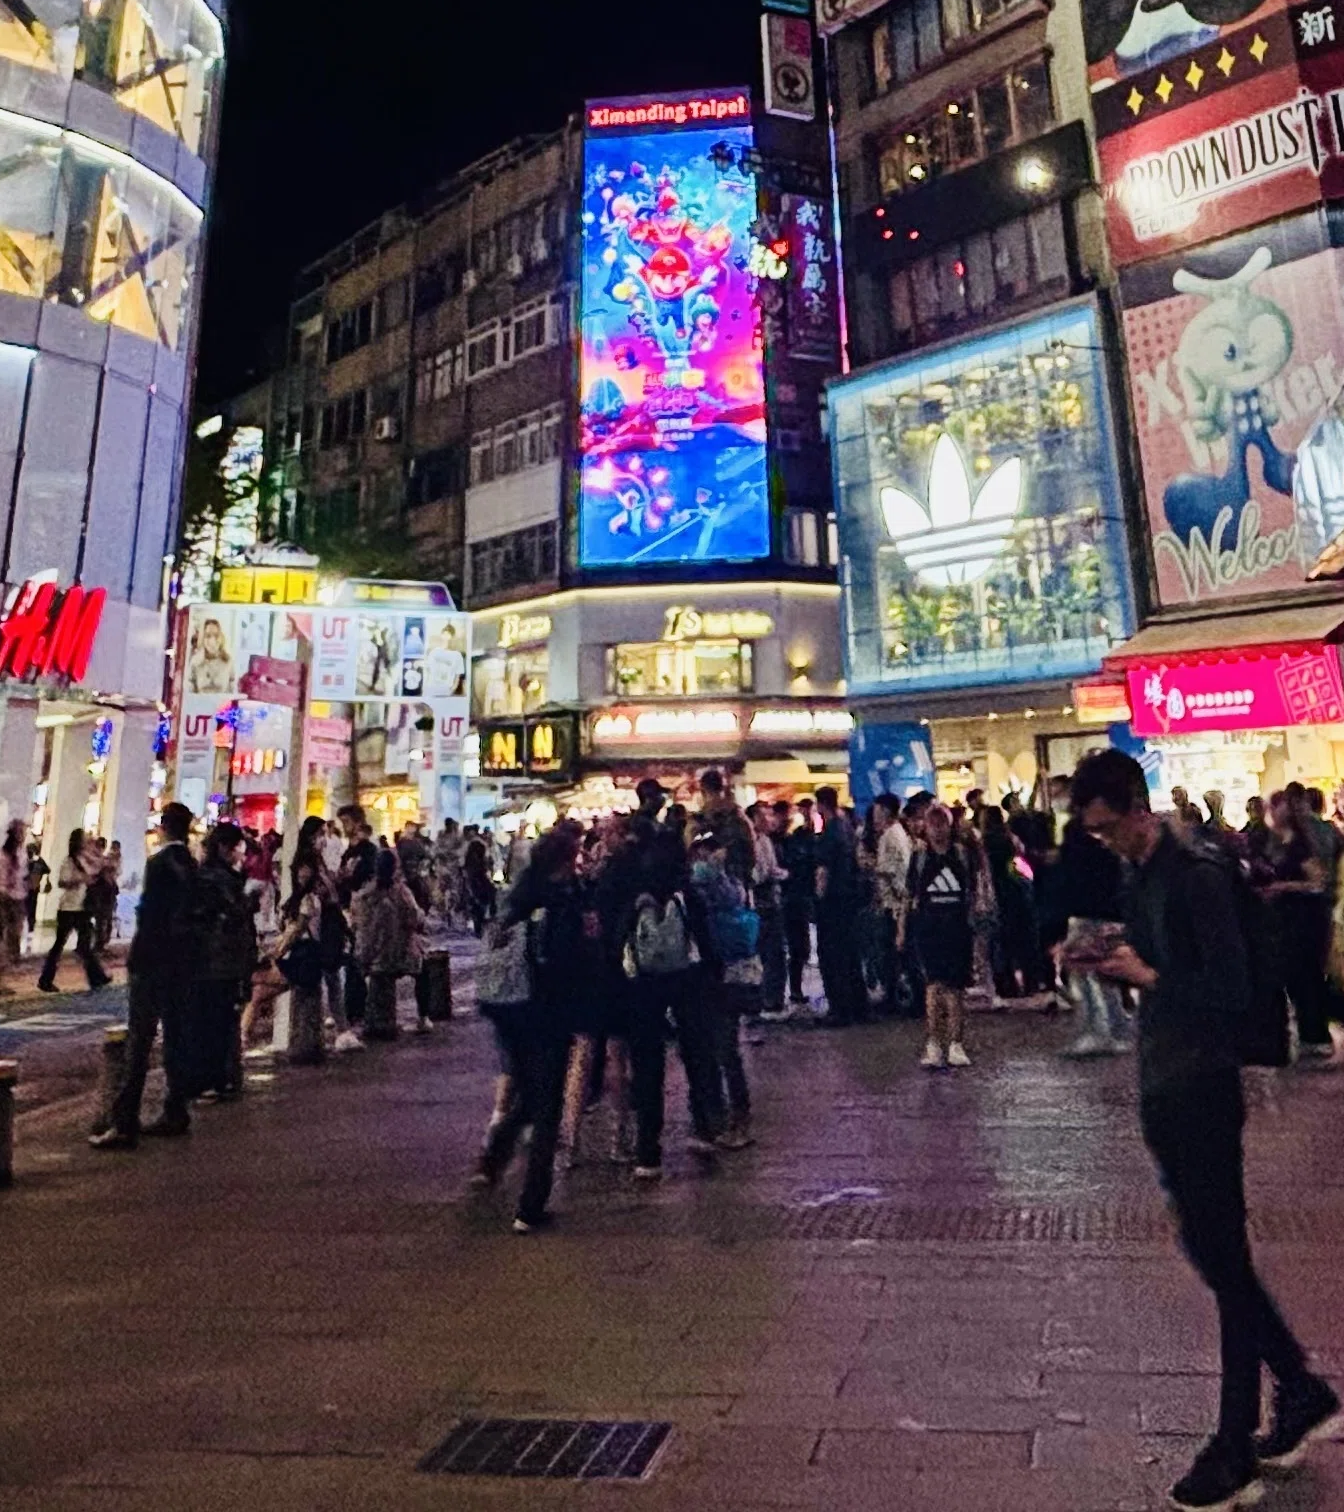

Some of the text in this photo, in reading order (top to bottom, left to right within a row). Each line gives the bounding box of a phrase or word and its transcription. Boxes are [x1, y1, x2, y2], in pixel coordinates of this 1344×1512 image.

[590, 95, 746, 127] Ximending Taipei
[321, 616, 351, 640] UT
[184, 714, 213, 737] UT
[440, 716, 465, 737] UT
